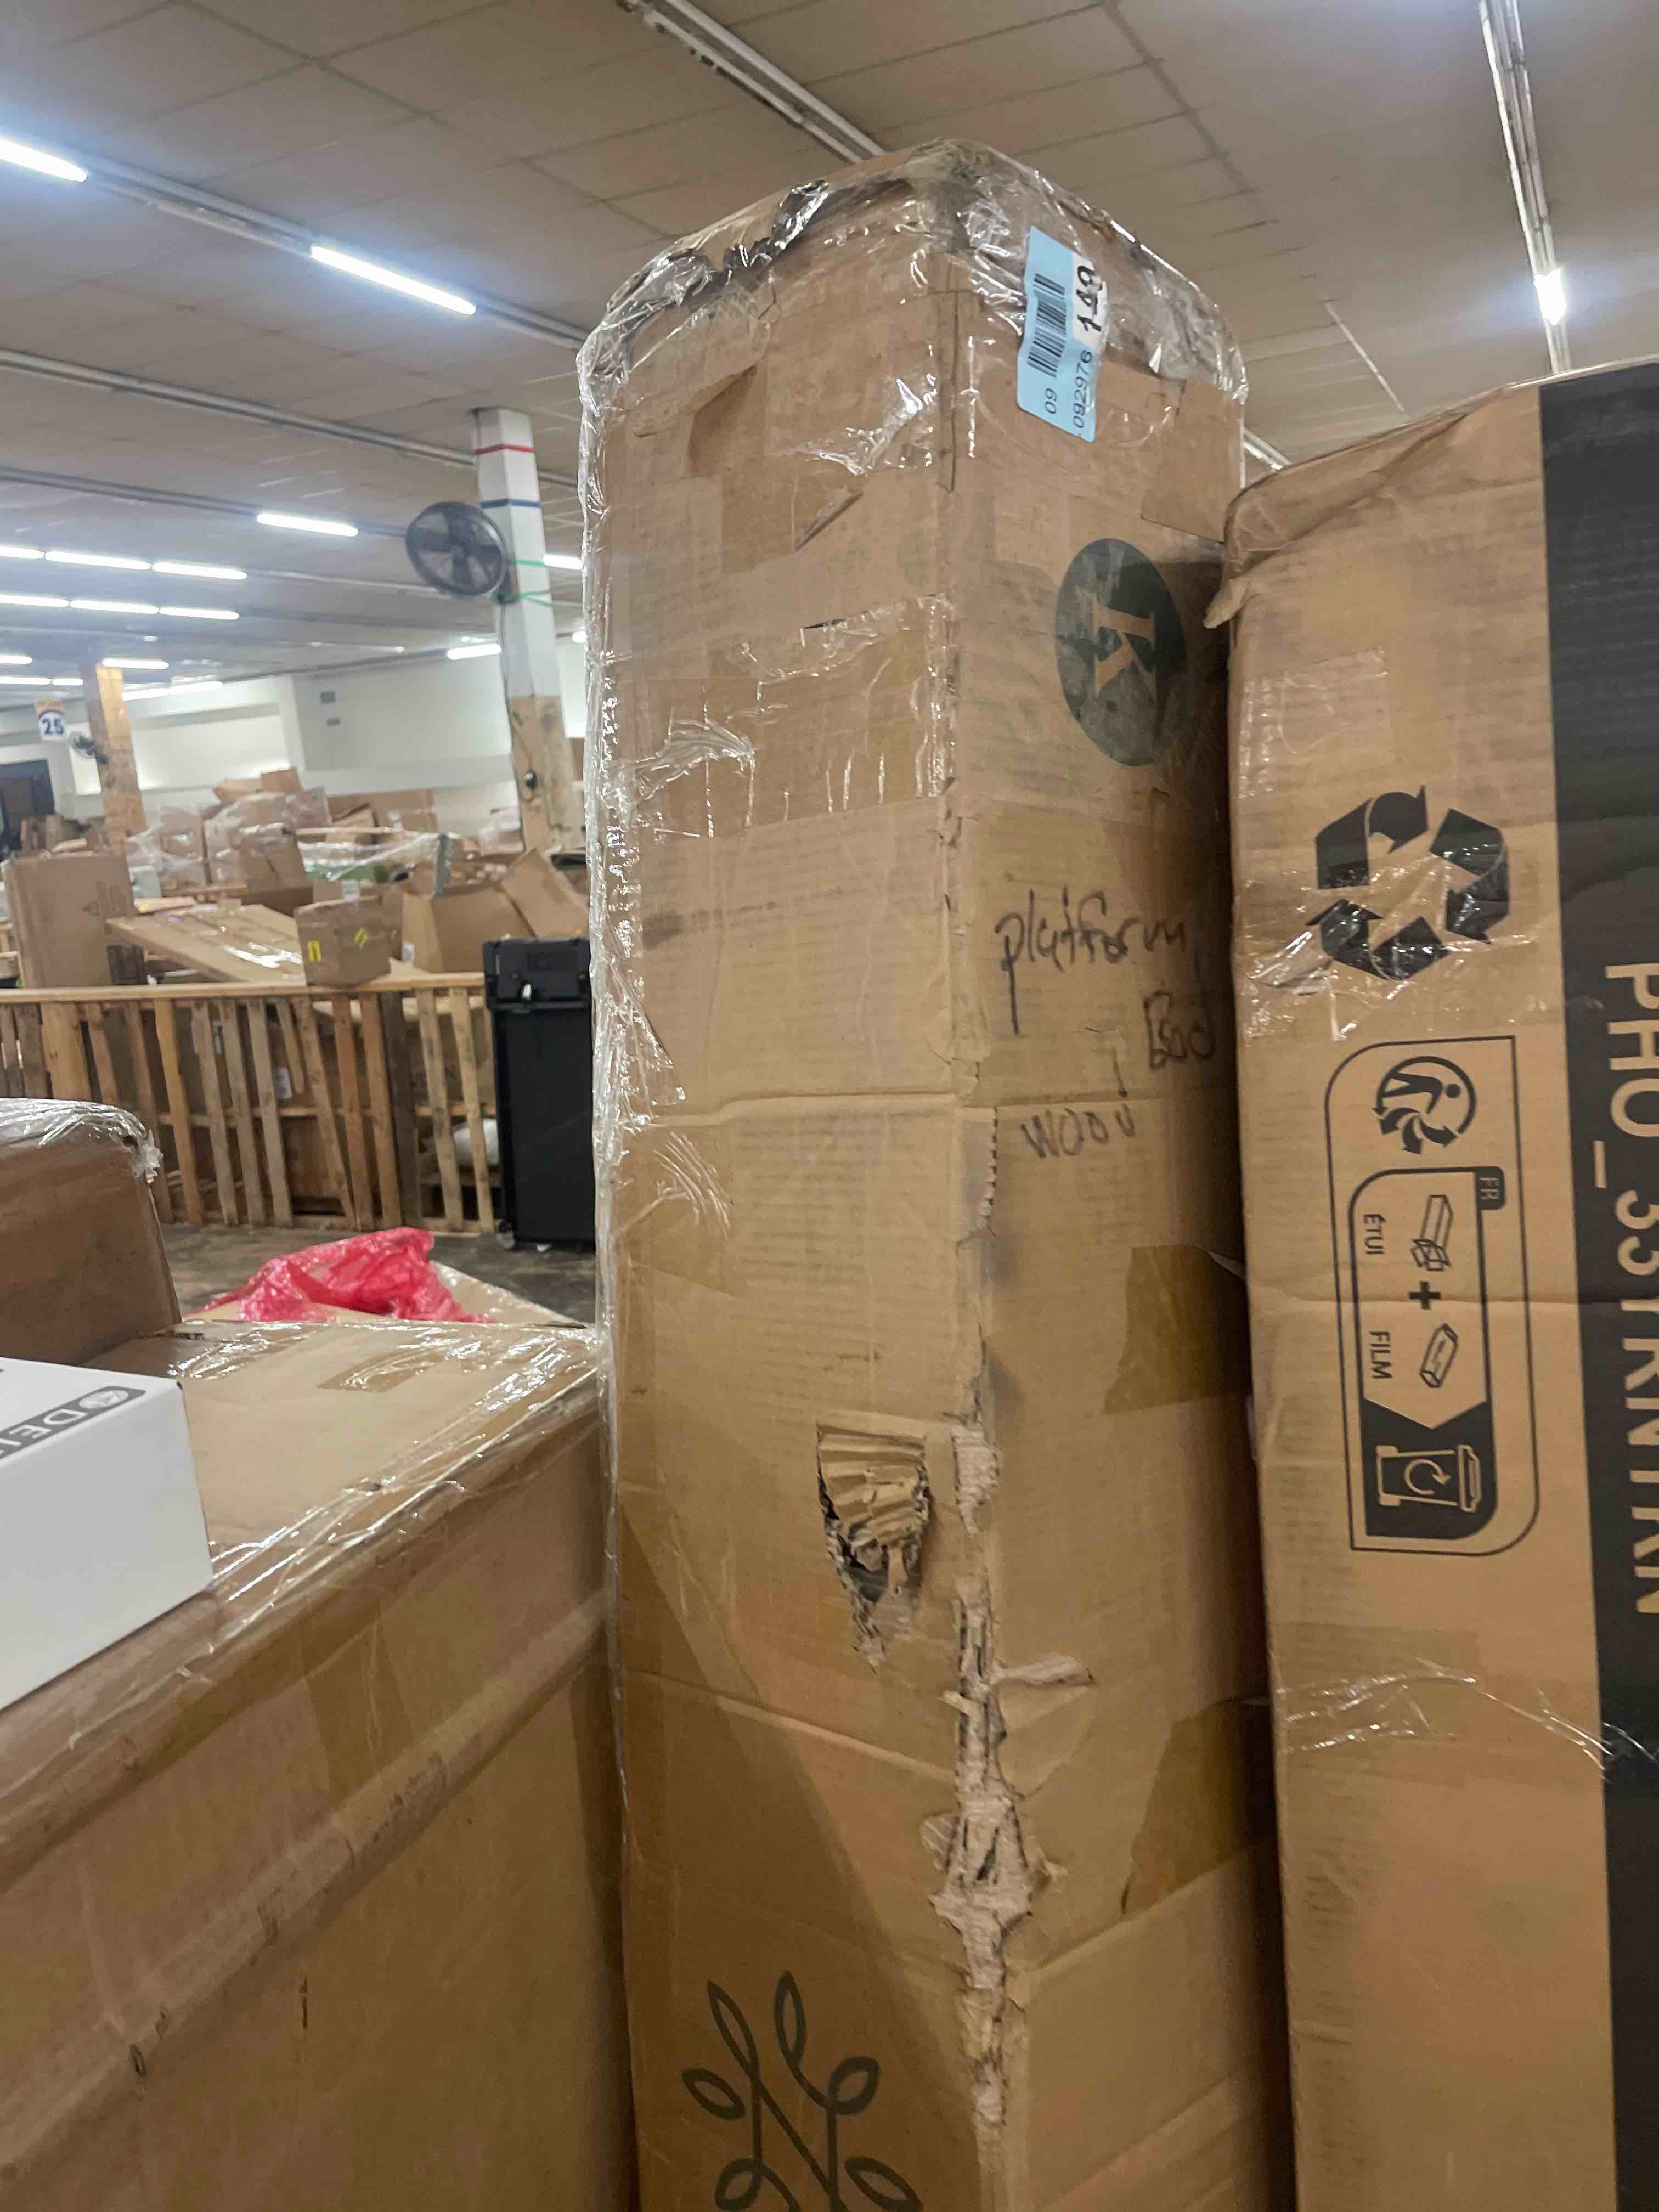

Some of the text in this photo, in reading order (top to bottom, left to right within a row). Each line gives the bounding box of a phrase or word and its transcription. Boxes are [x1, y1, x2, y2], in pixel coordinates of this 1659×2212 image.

[1076, 265, 1103, 332] 149
[1044, 387, 1059, 415] 09
[1073, 349, 1093, 429] 092976
[1479, 1177, 1500, 1201] FR
[1363, 1214, 1386, 1255] ÉTUI
[1369, 1331, 1393, 1379] FILM
